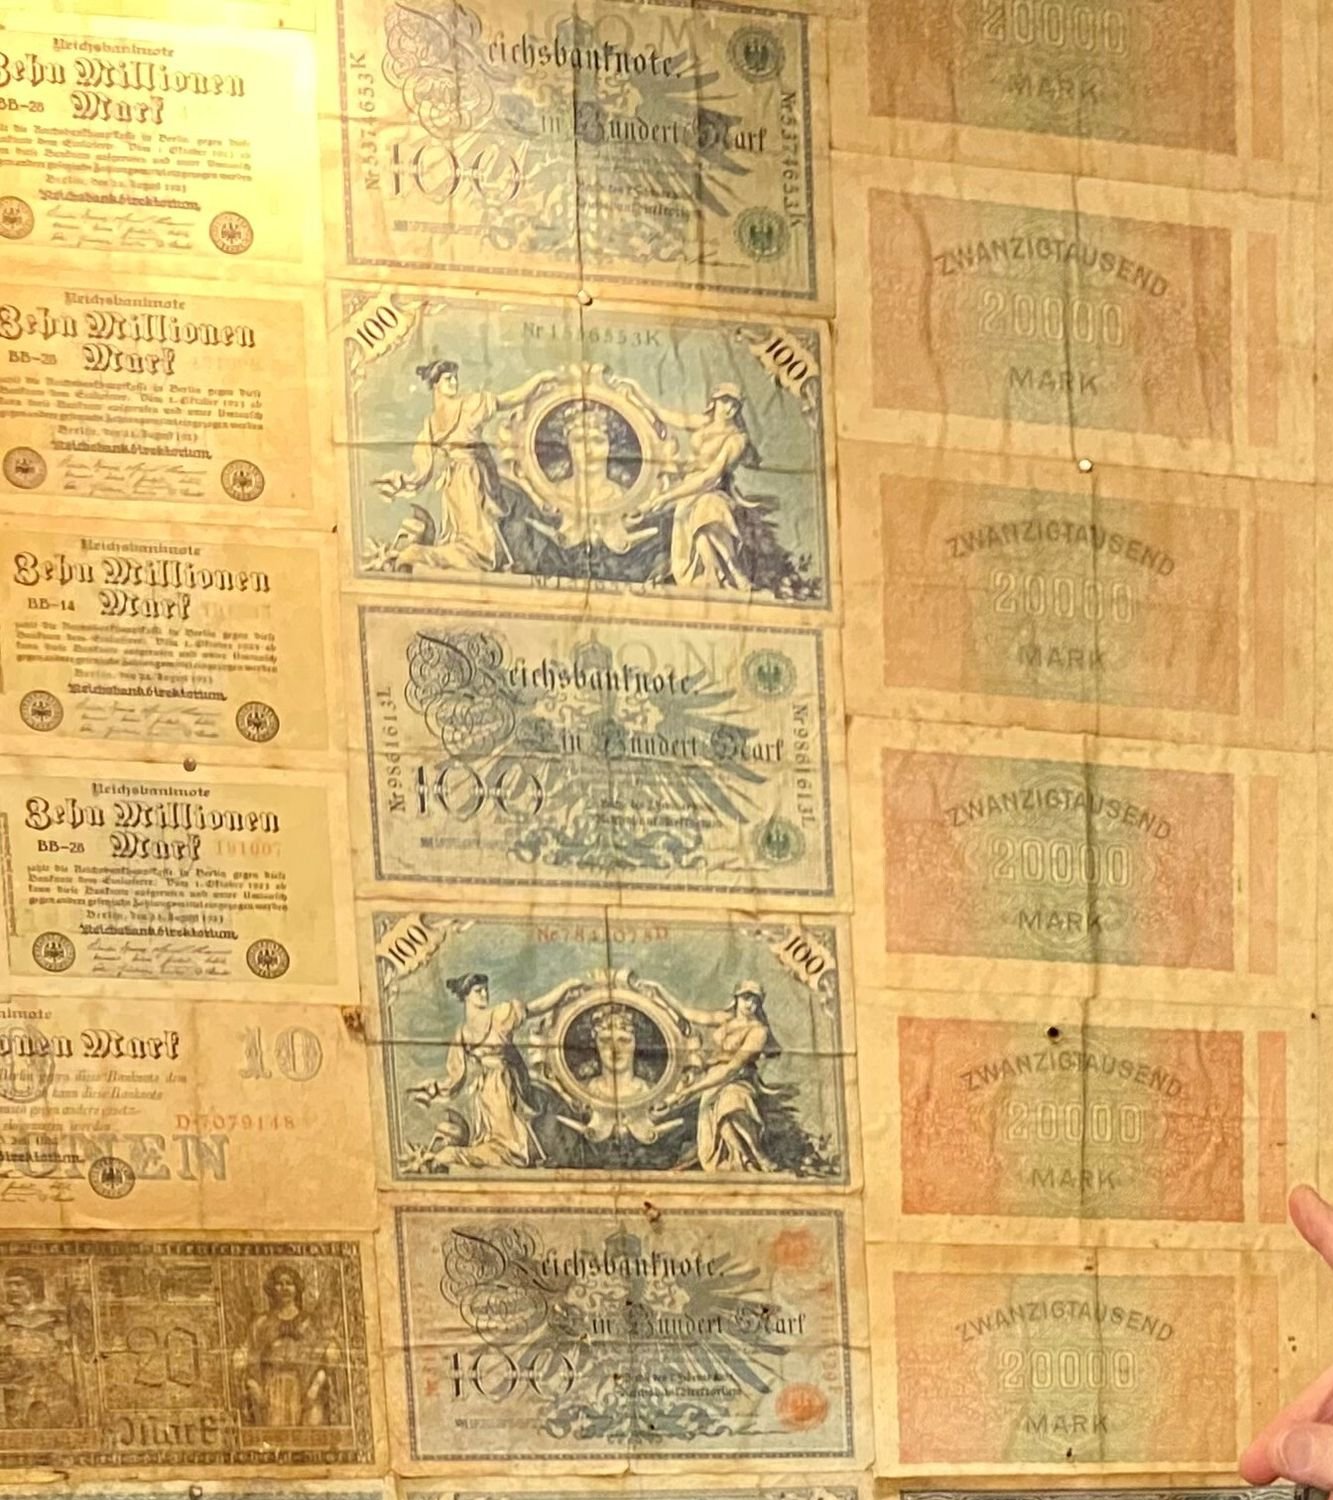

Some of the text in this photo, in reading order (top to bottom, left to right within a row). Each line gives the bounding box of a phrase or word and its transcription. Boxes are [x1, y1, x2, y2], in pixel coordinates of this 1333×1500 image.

[74, 56, 245, 97] Millionen
[70, 91, 164, 124] Mark
[934, 236, 1168, 299] ZWANZIGTAUSEND
[86, 310, 256, 348] Millionen
[356, 304, 400, 350] 100
[978, 288, 1125, 348] 20000
[82, 344, 175, 375] Mark
[764, 336, 809, 383] 100
[1009, 366, 1099, 395] MARK
[946, 519, 1176, 577] ZWANZIGTAUSEND
[13, 551, 271, 593] Zehn Millionen
[99, 589, 191, 620] Mark
[990, 569, 1134, 626] 20000
[1019, 645, 1106, 671] MARK
[416, 763, 544, 821] 100
[26, 796, 280, 833] Zehn Millionen
[944, 787, 1172, 841] ZWANZIGTAUSEND
[110, 831, 201, 861] Mark
[989, 835, 1131, 888] 20000
[1018, 910, 1104, 933] MARK
[387, 923, 428, 968] 100
[783, 936, 826, 976] 100
[80, 1029, 180, 1060] Mark
[960, 1050, 1184, 1099] ZWANZIGTAUSEND
[1006, 1102, 1143, 1145] 20000
[1032, 1168, 1115, 1190] MARK
[955, 1299, 1175, 1343] ZWANZIGTAUSEND
[451, 1350, 576, 1399] 100
[1000, 1348, 1137, 1390] 20000
[1025, 1414, 1108, 1434] MARK
